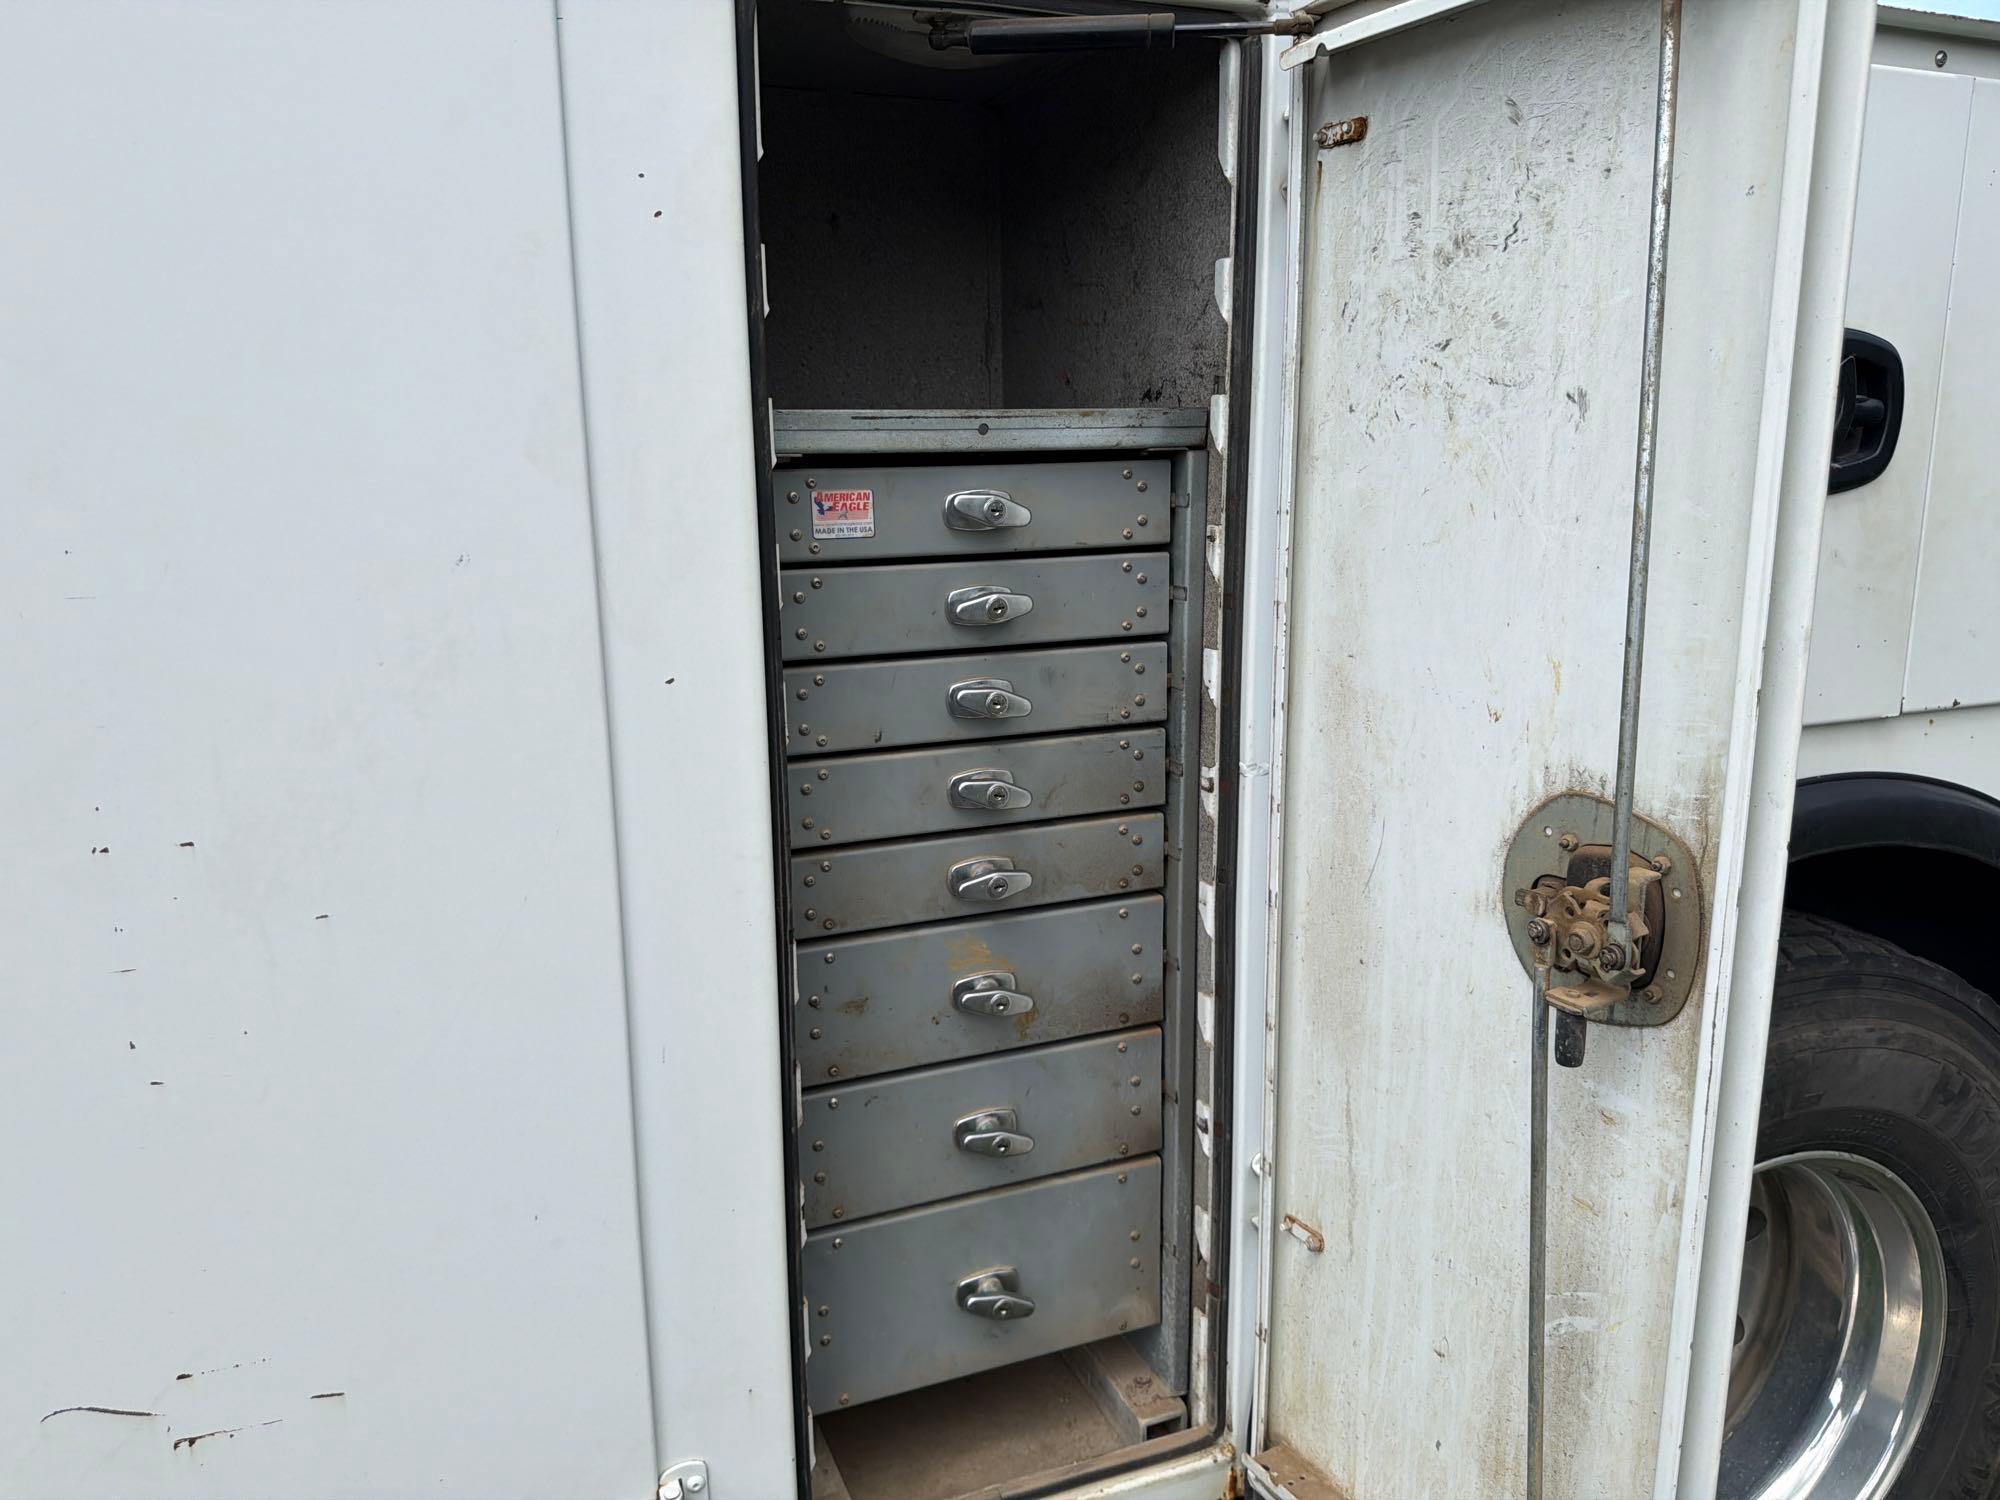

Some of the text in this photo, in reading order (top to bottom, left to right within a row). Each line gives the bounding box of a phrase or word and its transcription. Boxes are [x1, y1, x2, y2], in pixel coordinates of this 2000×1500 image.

[816, 491, 870, 502] AMERICAN
[832, 502, 870, 512] EAGLE
[815, 527, 836, 535] MADE
